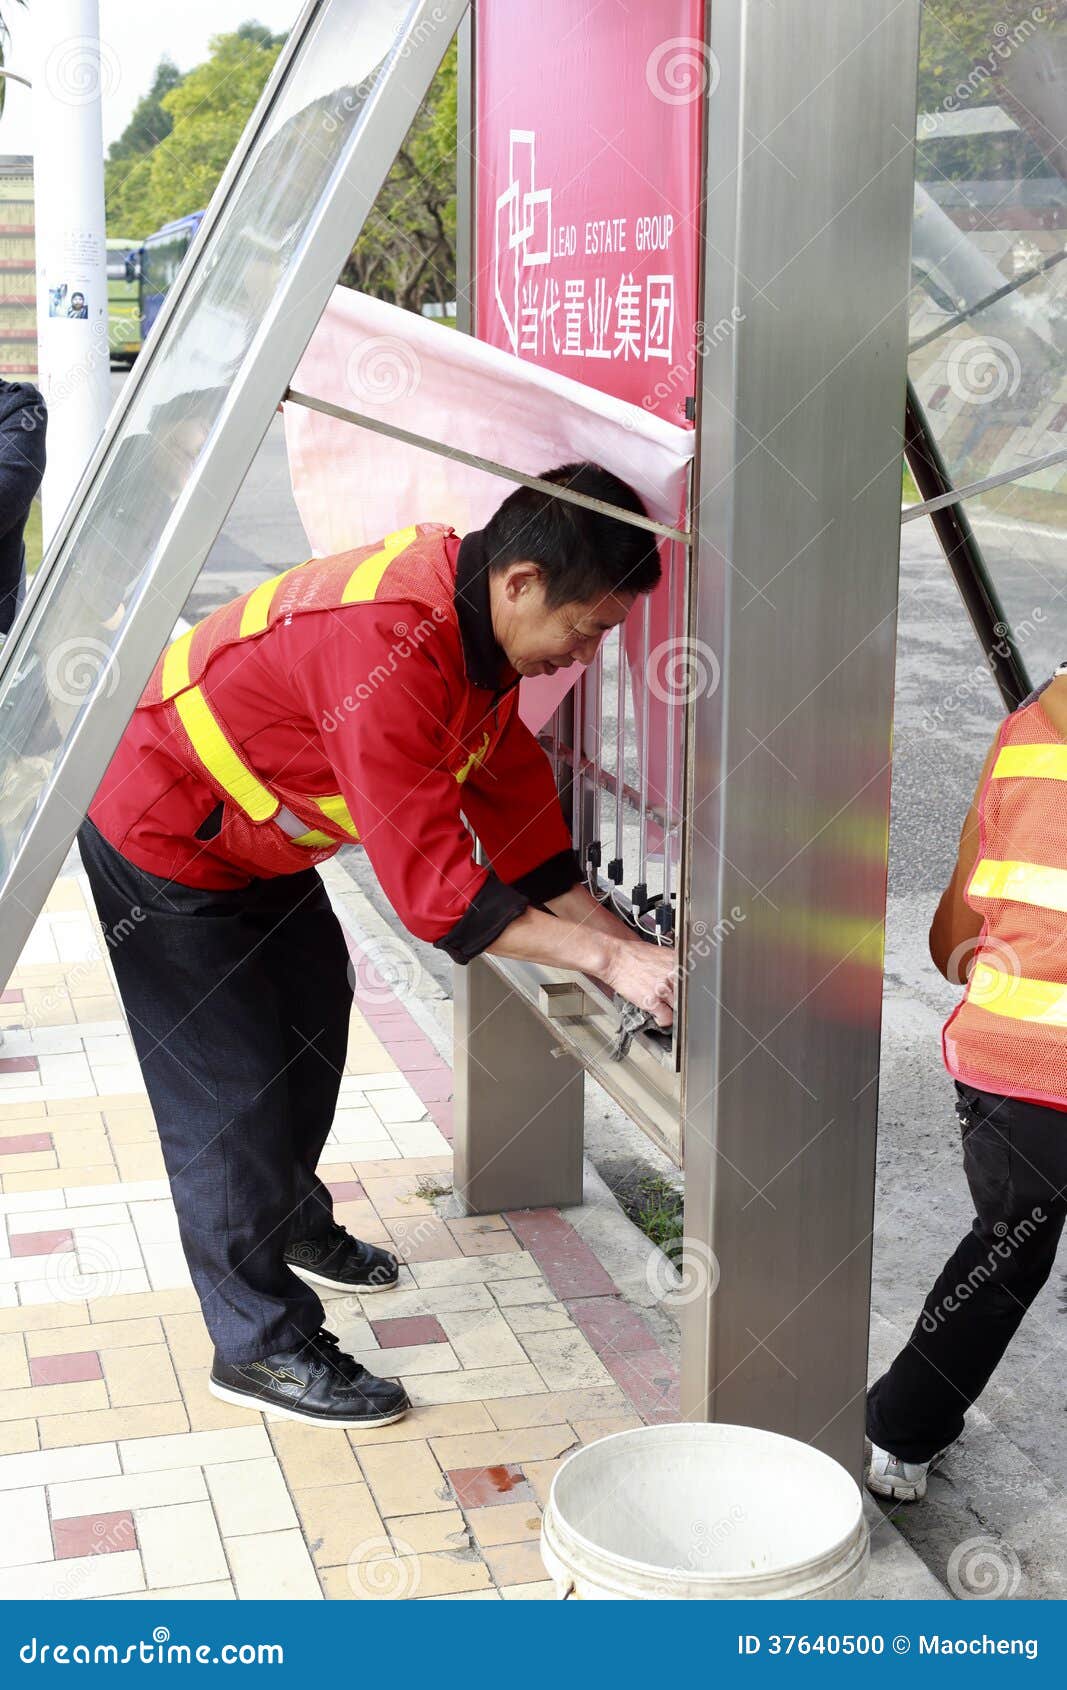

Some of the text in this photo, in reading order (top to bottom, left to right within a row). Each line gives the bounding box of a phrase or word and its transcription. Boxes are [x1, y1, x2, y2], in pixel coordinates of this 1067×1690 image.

[553, 214, 674, 257] LEAD ESTATE GROUP
[520, 272, 674, 365] 当代置业集团
